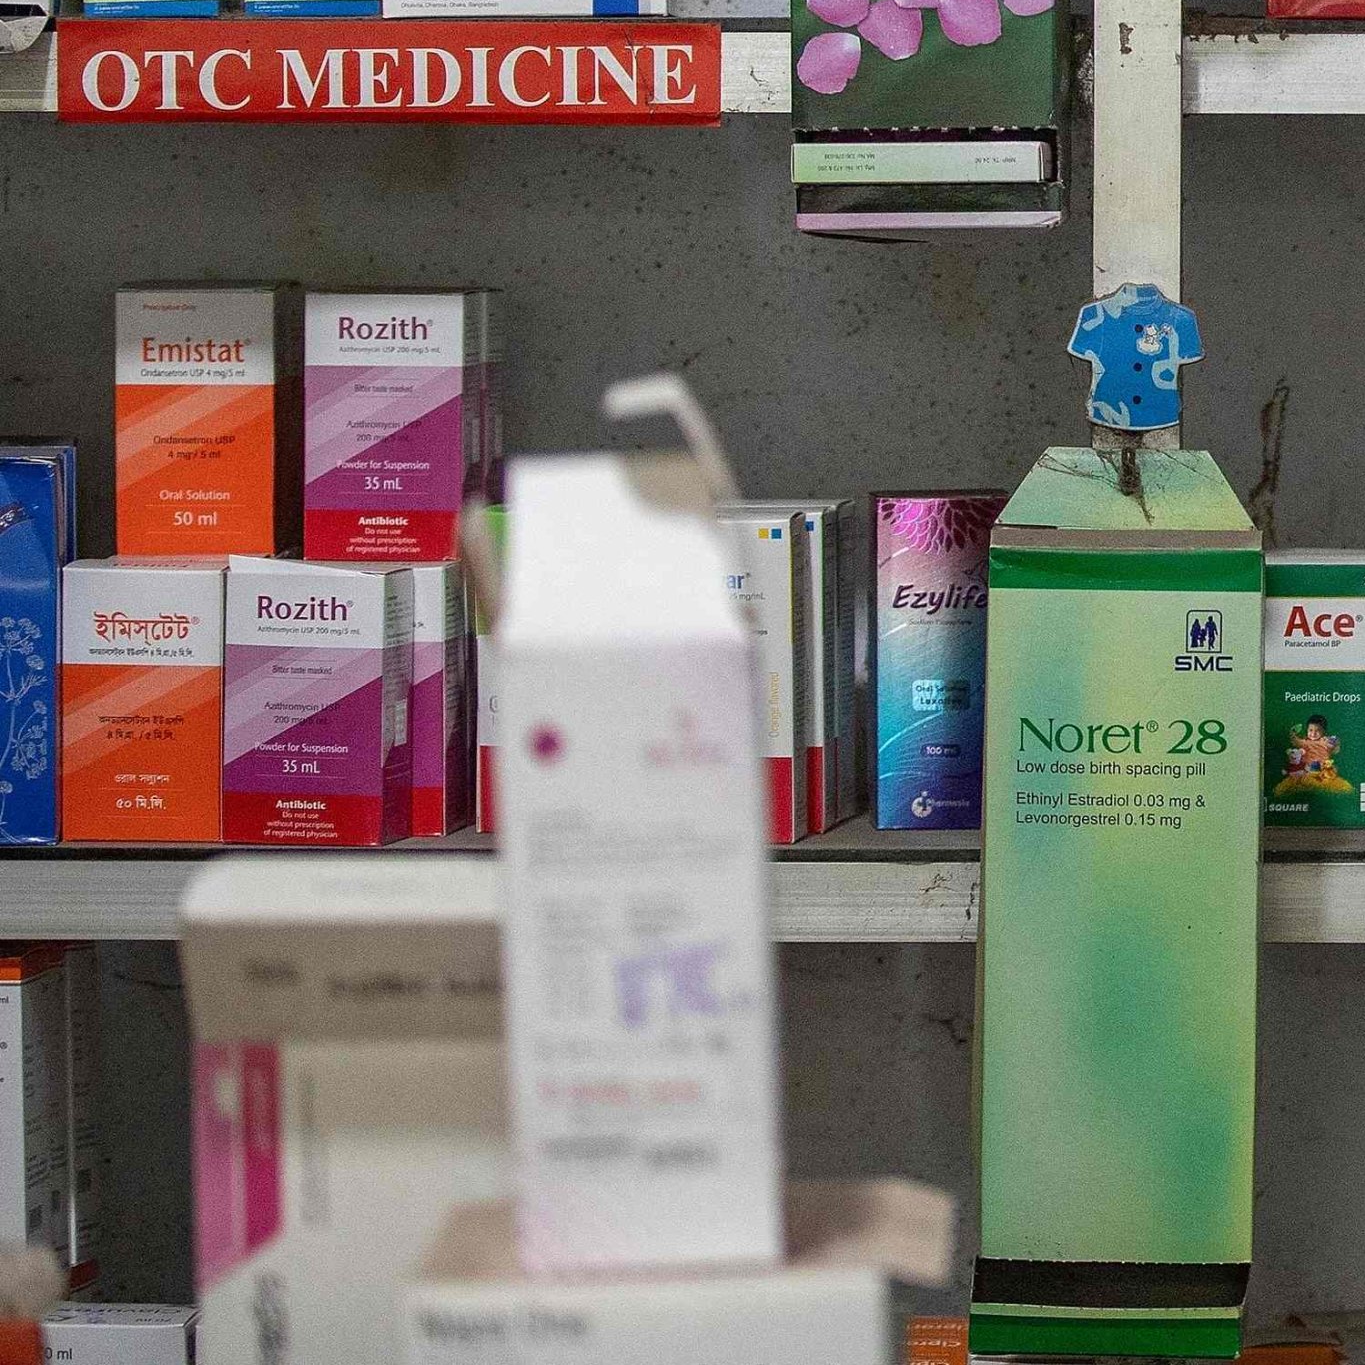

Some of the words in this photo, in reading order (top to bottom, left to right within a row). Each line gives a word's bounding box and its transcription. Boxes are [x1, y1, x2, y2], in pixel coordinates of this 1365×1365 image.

[82, 48, 254, 112] OTC
[277, 44, 696, 112] MEDICINE
[338, 316, 428, 340] Rozith
[141, 337, 244, 363] Emistat
[358, 516, 408, 525] Antibiotic
[257, 595, 348, 621] Rozith
[1284, 605, 1355, 638] Ace
[1175, 656, 1233, 672] SMC
[1285, 692, 1331, 702] Paediatric
[1333, 692, 1361, 703] Drops
[1019, 717, 1147, 755] Noret
[1167, 719, 1227, 755] 28
[1016, 760, 1044, 773] Low
[1050, 760, 1085, 774] dose
[1089, 761, 1121, 774] birth
[1126, 762, 1182, 778] spacing
[1186, 762, 1206, 778] pill
